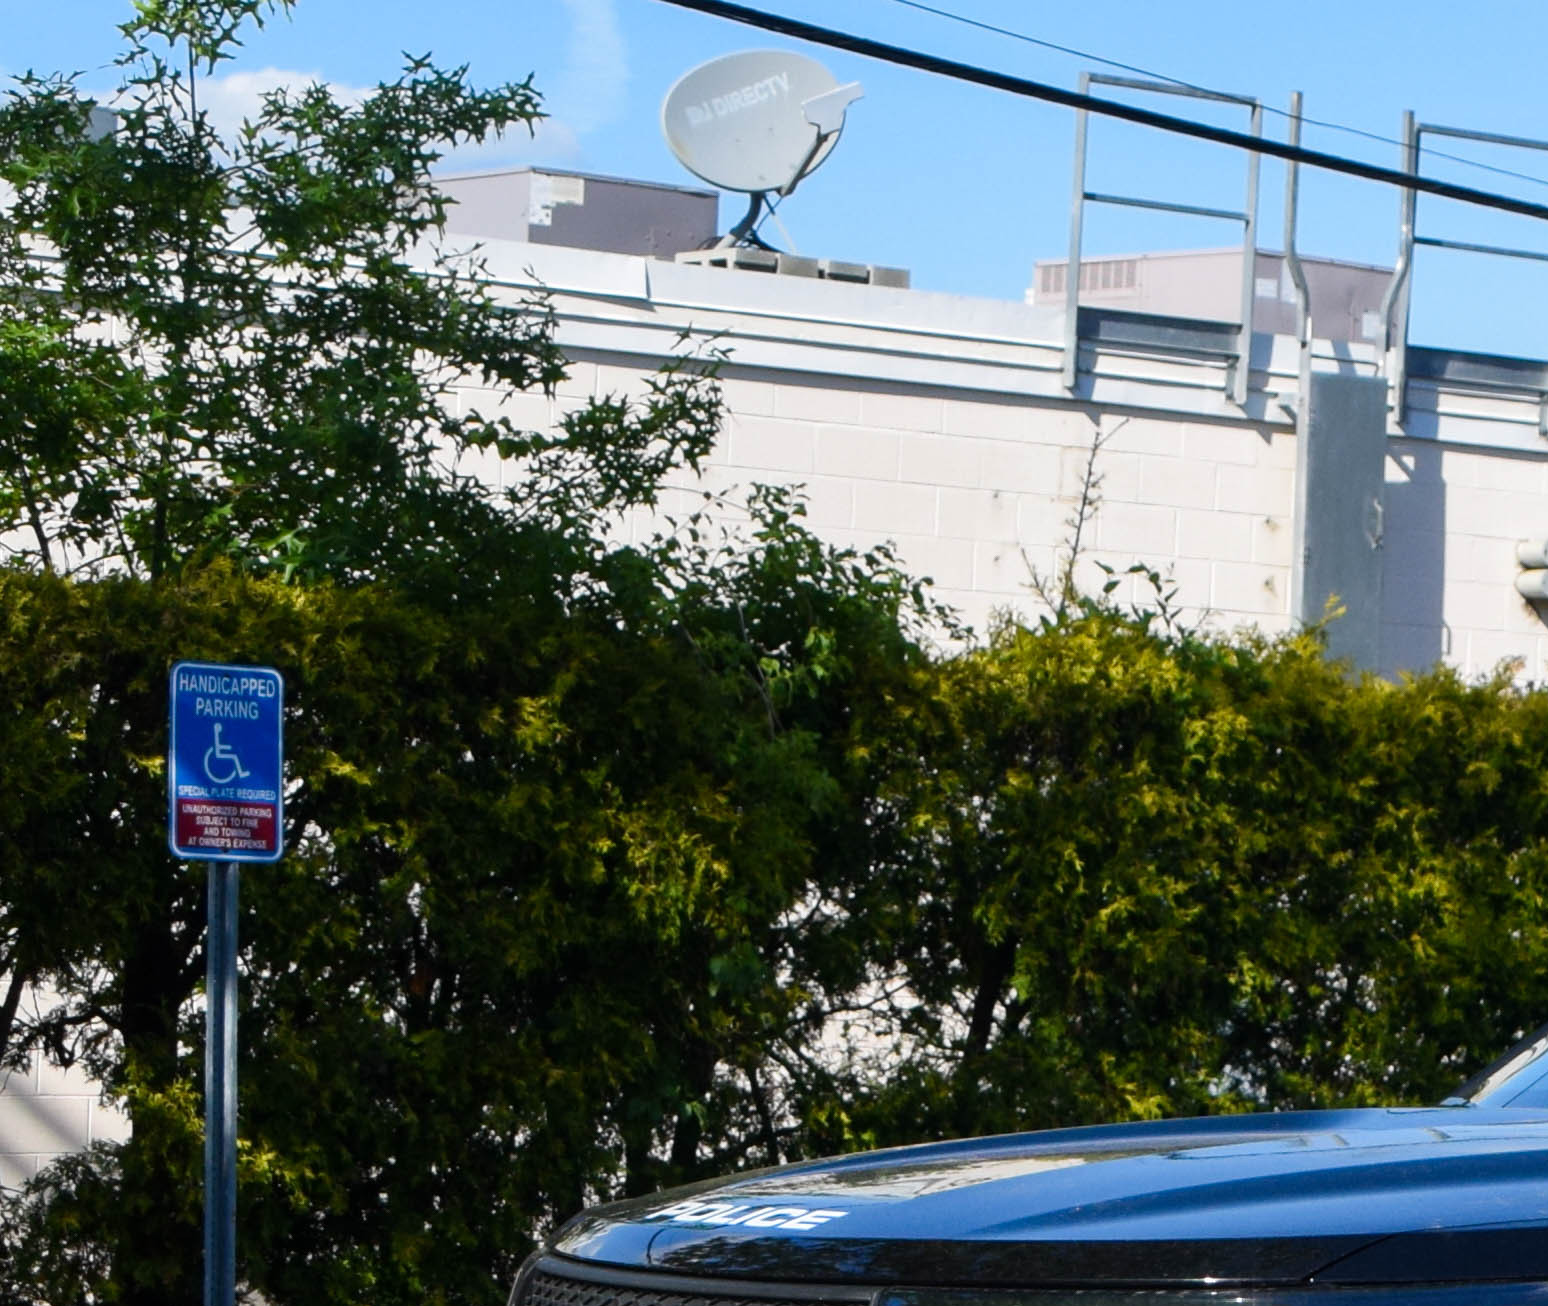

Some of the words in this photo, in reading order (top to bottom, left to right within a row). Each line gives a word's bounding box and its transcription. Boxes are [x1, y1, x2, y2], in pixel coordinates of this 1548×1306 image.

[712, 72, 790, 116] DIRECTV
[180, 673, 275, 697] HANDICAPPED
[196, 697, 258, 719] PARKING
[178, 785, 208, 797] SPECIAL
[211, 787, 235, 798] PLATE
[237, 788, 276, 800] REQUIRED
[182, 804, 237, 815] UNAUTHORIZED
[240, 807, 272, 818] PARKING
[196, 816, 227, 826] SUBJECT
[231, 817, 240, 826] TO
[204, 827, 219, 836] AND
[188, 836, 196, 845] AT
[644, 1201, 849, 1231] POLICE
